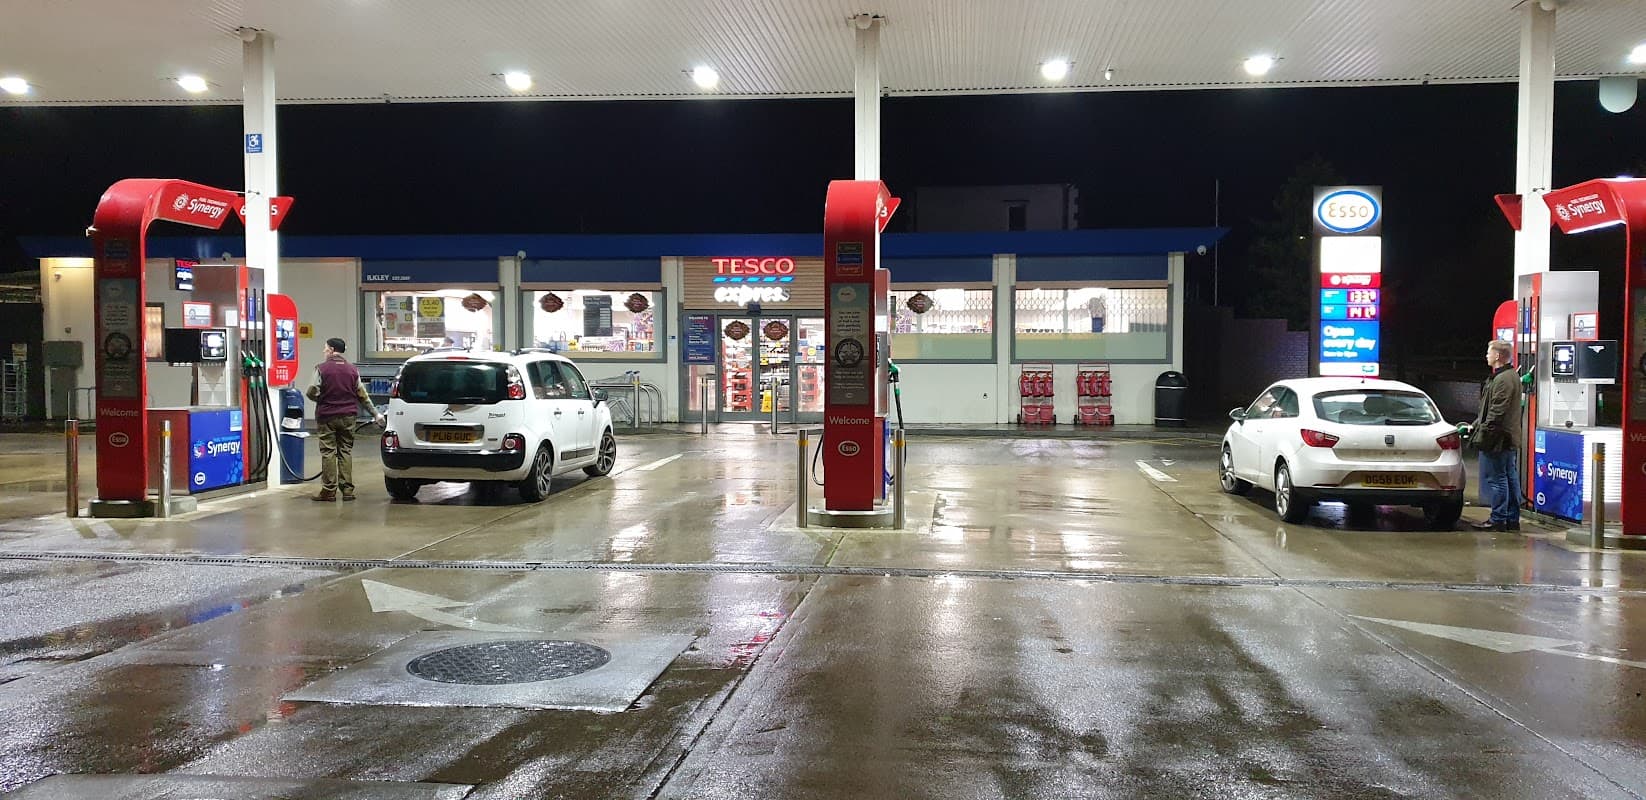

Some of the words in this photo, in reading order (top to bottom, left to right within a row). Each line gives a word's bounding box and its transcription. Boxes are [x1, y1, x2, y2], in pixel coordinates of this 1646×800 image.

[187, 198, 224, 219] Synergy
[271, 204, 278, 216] 5
[880, 206, 888, 217] 3
[1328, 202, 1369, 218] Esso
[1567, 199, 1606, 219] Synergy
[712, 258, 795, 275] TESCO
[1323, 325, 1355, 339] Open
[1323, 338, 1354, 351] every
[1355, 337, 1376, 351] day
[100, 407, 139, 417] Welcome
[829, 415, 870, 425] Welcome
[207, 440, 241, 457] Synergy
[841, 444, 857, 452] Esso
[1547, 462, 1578, 485] Synergy
